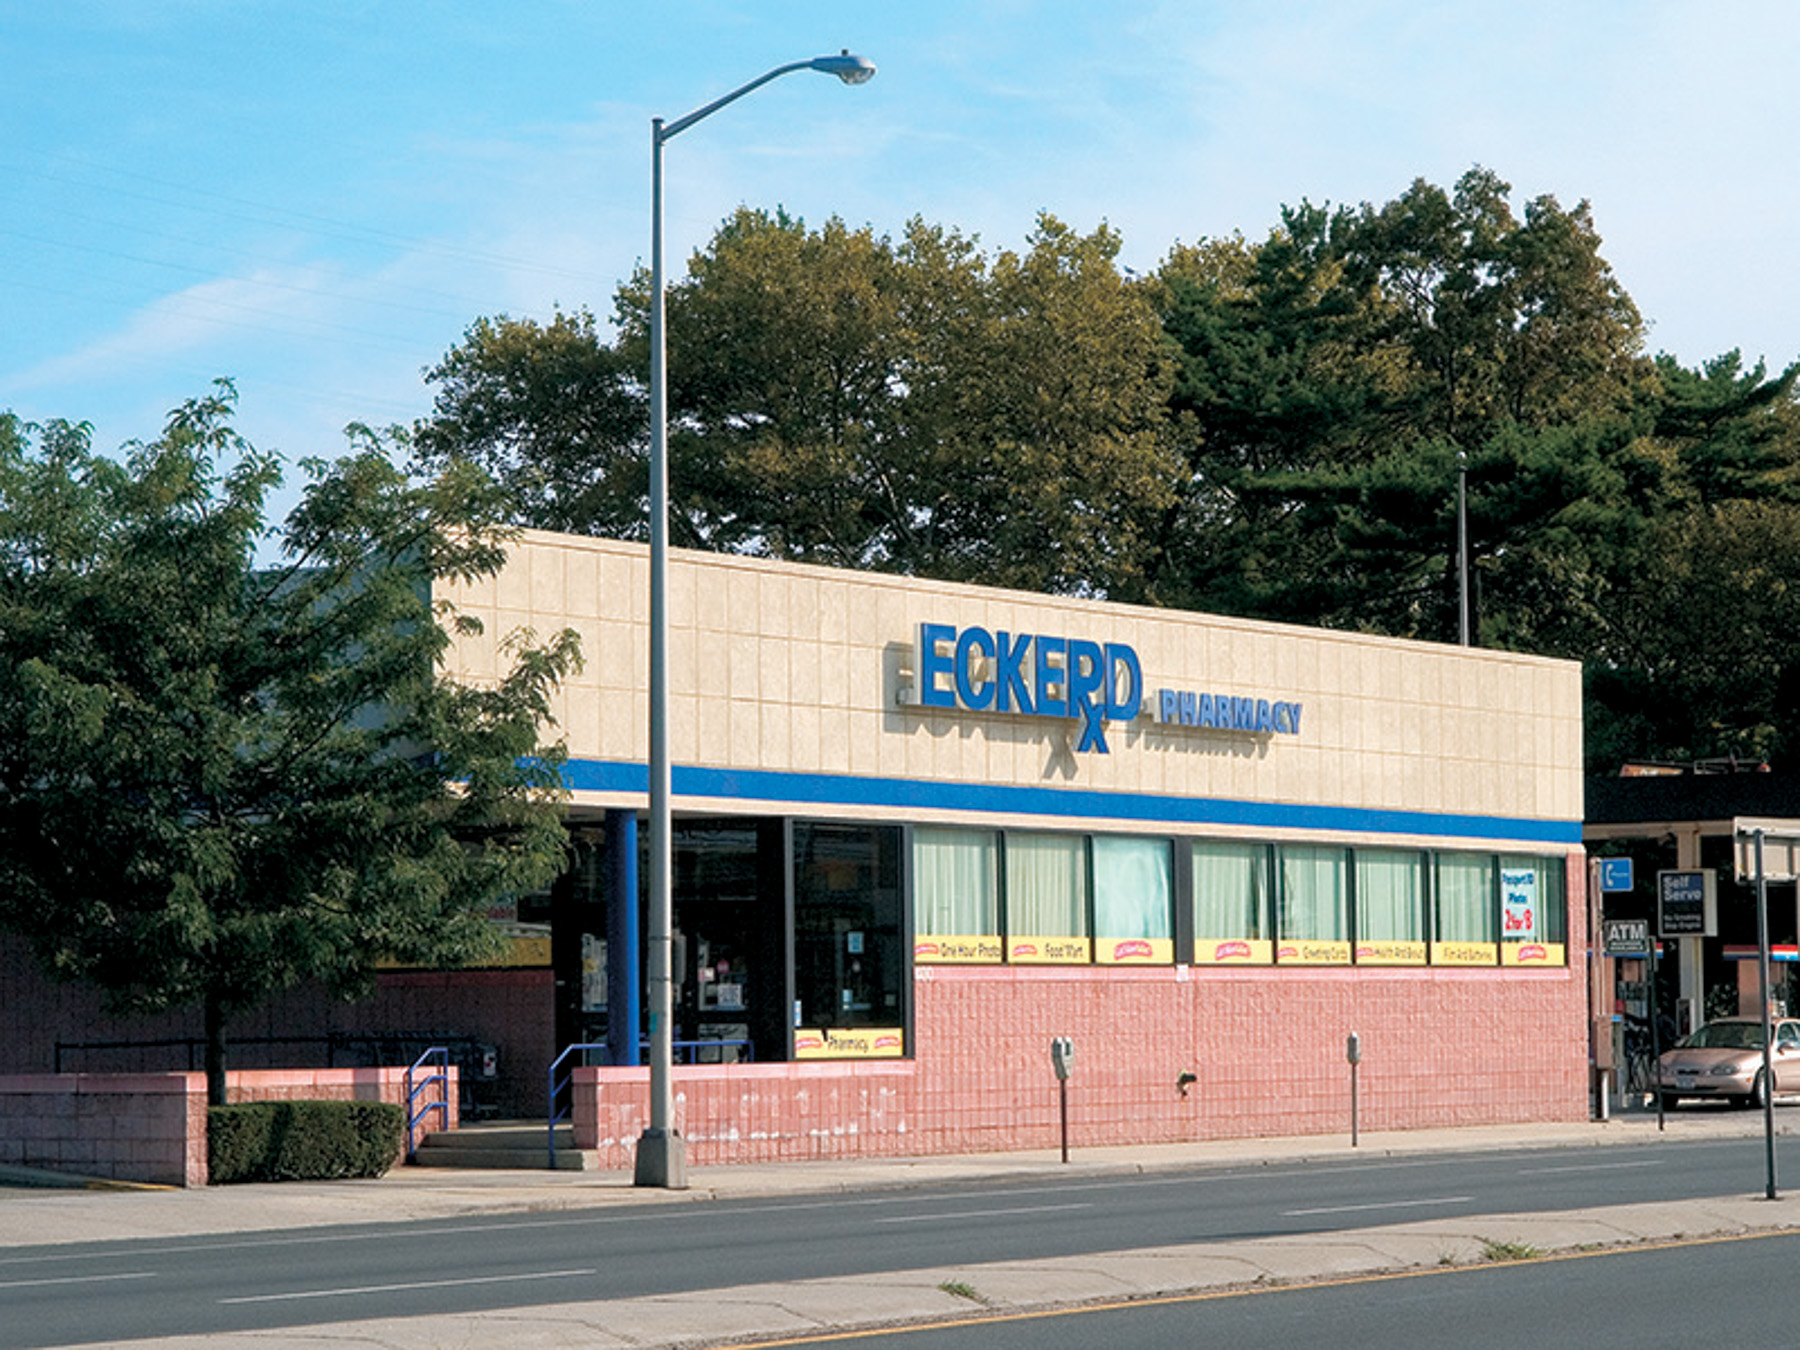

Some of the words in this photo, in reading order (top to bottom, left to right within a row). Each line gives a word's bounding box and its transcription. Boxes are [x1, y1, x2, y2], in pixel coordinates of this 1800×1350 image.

[915, 622, 1144, 722] ECKERD
[1158, 688, 1302, 735] PHARMACY
[1663, 876, 1689, 889] Self
[1664, 890, 1702, 901] Serve
[1608, 923, 1645, 940] ATM
